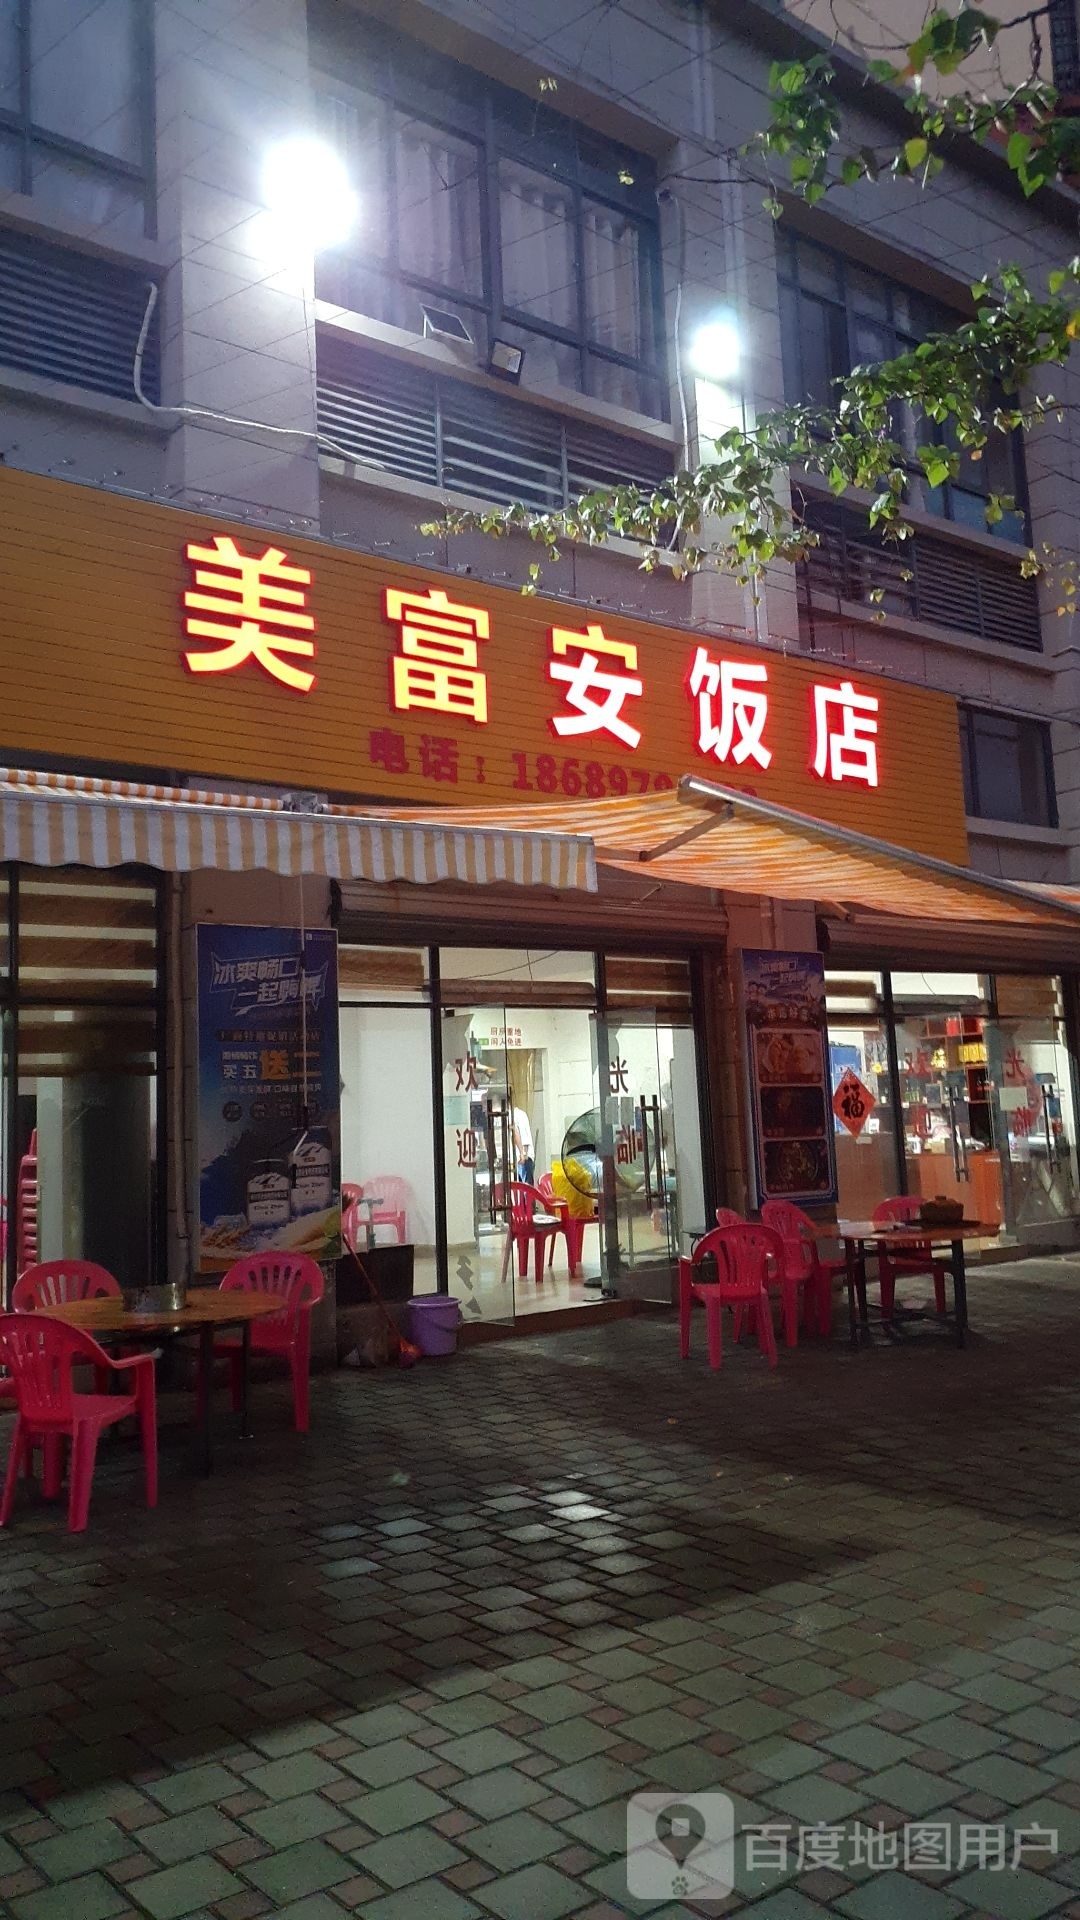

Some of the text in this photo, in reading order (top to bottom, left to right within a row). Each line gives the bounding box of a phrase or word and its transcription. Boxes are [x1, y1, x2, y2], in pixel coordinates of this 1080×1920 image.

[183, 535, 880, 788] 美富安饭店
[454, 1050, 478, 1168] 欢迎
[841, 1083, 866, 1119] 福
